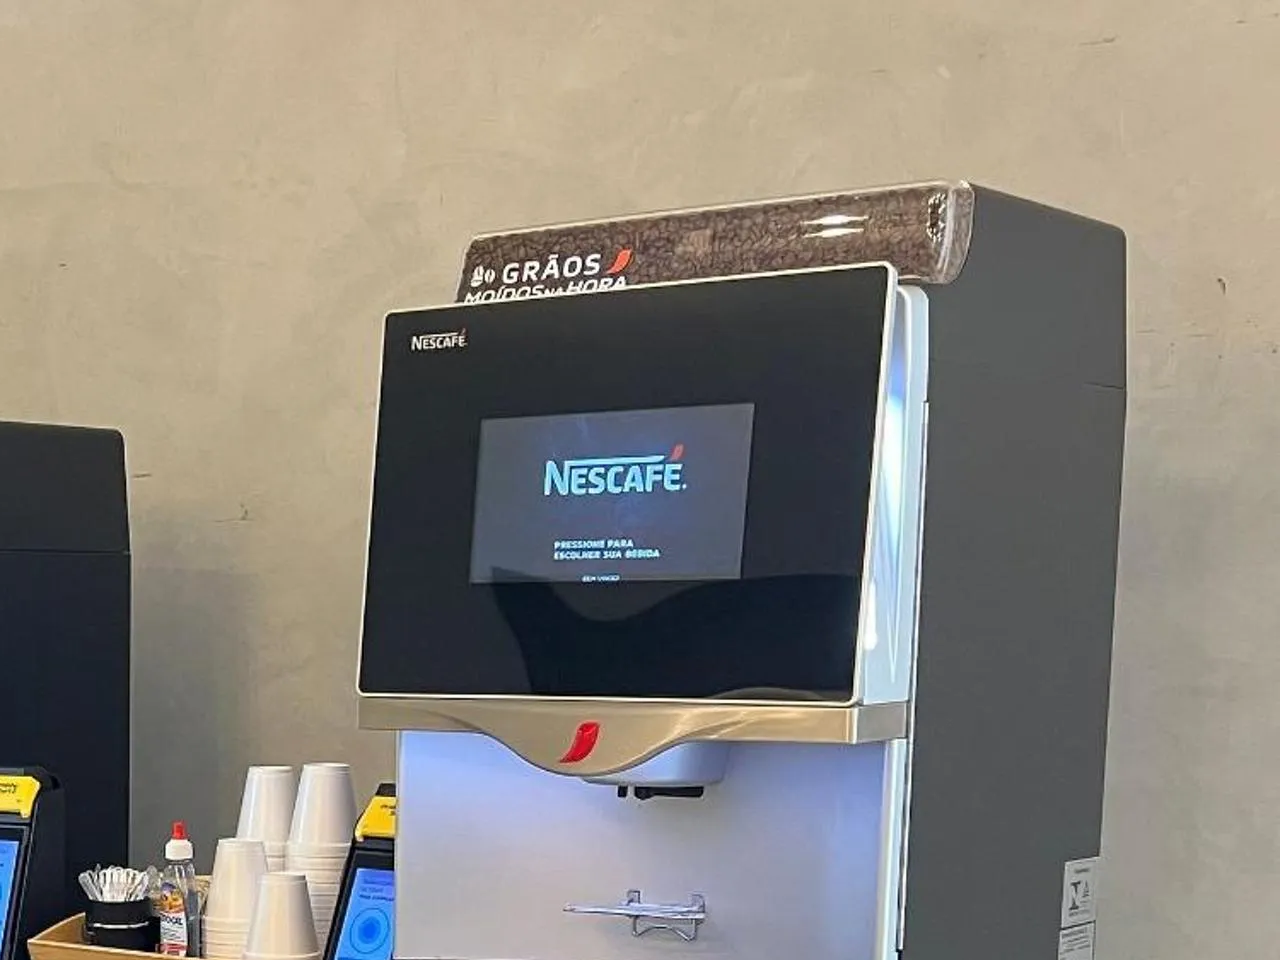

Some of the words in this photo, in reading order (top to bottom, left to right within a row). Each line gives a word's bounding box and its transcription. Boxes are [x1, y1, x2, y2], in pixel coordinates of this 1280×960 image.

[502, 254, 602, 284] GRÃOS
[607, 539, 634, 548] PARA
[602, 549, 622, 559] SUA
